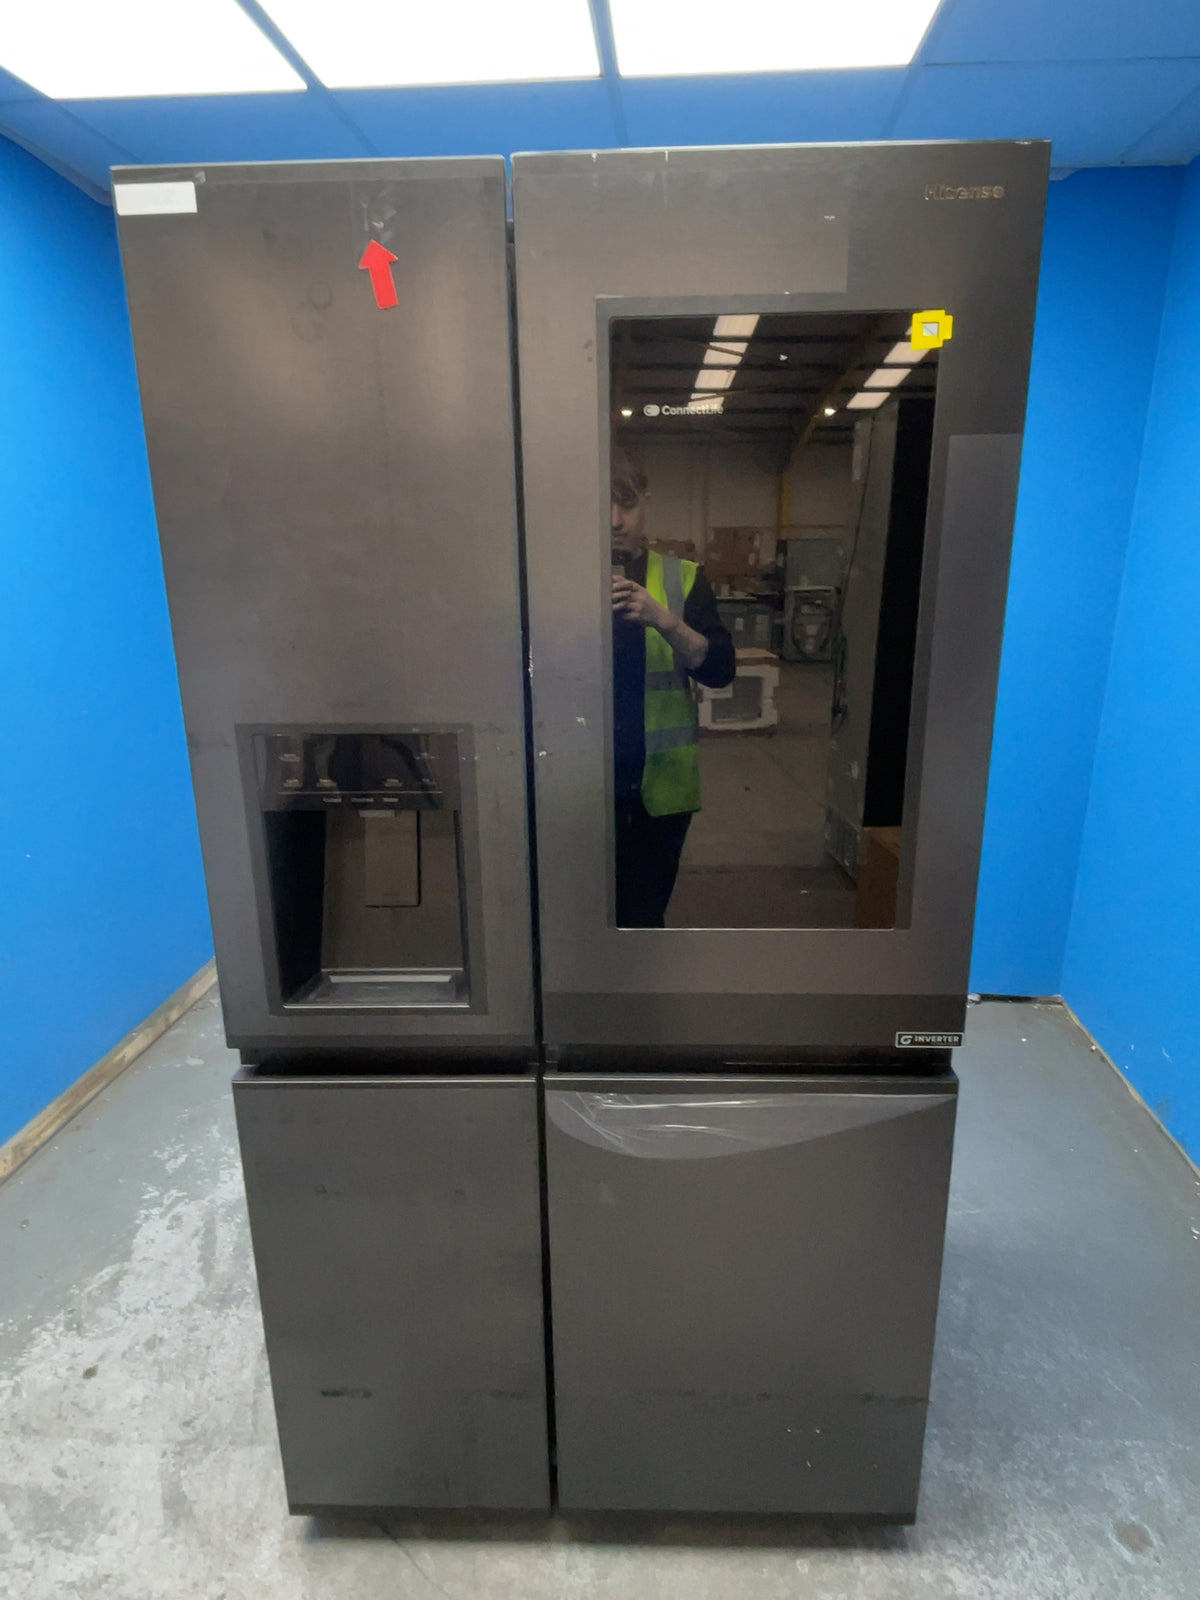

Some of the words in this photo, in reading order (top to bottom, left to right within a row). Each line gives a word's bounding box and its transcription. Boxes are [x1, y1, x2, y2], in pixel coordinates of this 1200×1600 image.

[924, 184, 1005, 200] Hisense
[661, 403, 724, 416] ConnectLife
[914, 1035, 960, 1043] INVERTER
